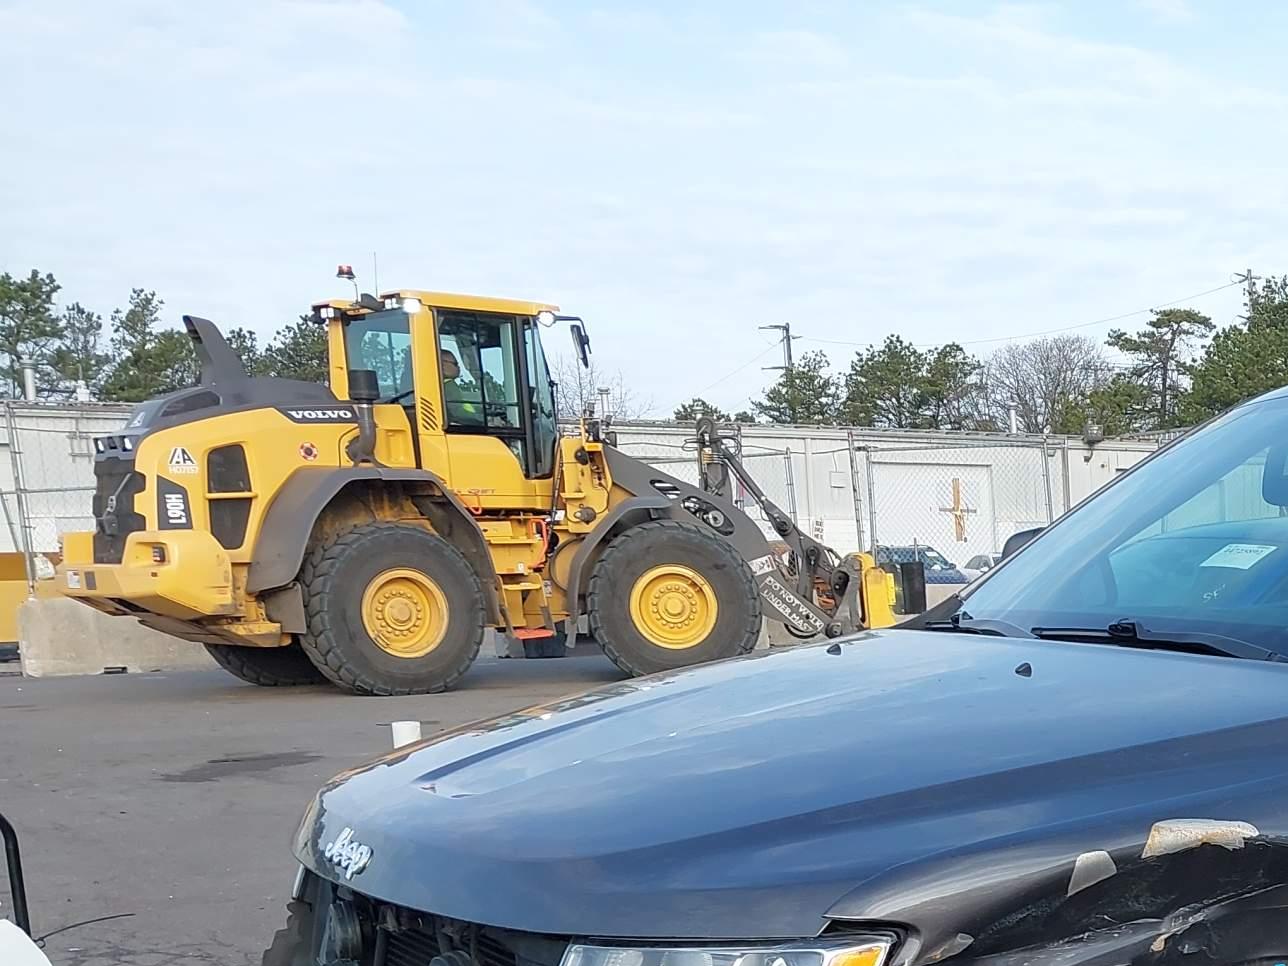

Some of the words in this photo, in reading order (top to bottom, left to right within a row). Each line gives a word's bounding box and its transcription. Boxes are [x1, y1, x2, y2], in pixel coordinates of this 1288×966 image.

[287, 410, 352, 419] VOLVO
[766, 576, 780, 591] DO
[780, 590, 800, 607] NOT
[763, 589, 792, 616] UNDER
[790, 613, 814, 632] MAST
[325, 827, 373, 880] Jeep
